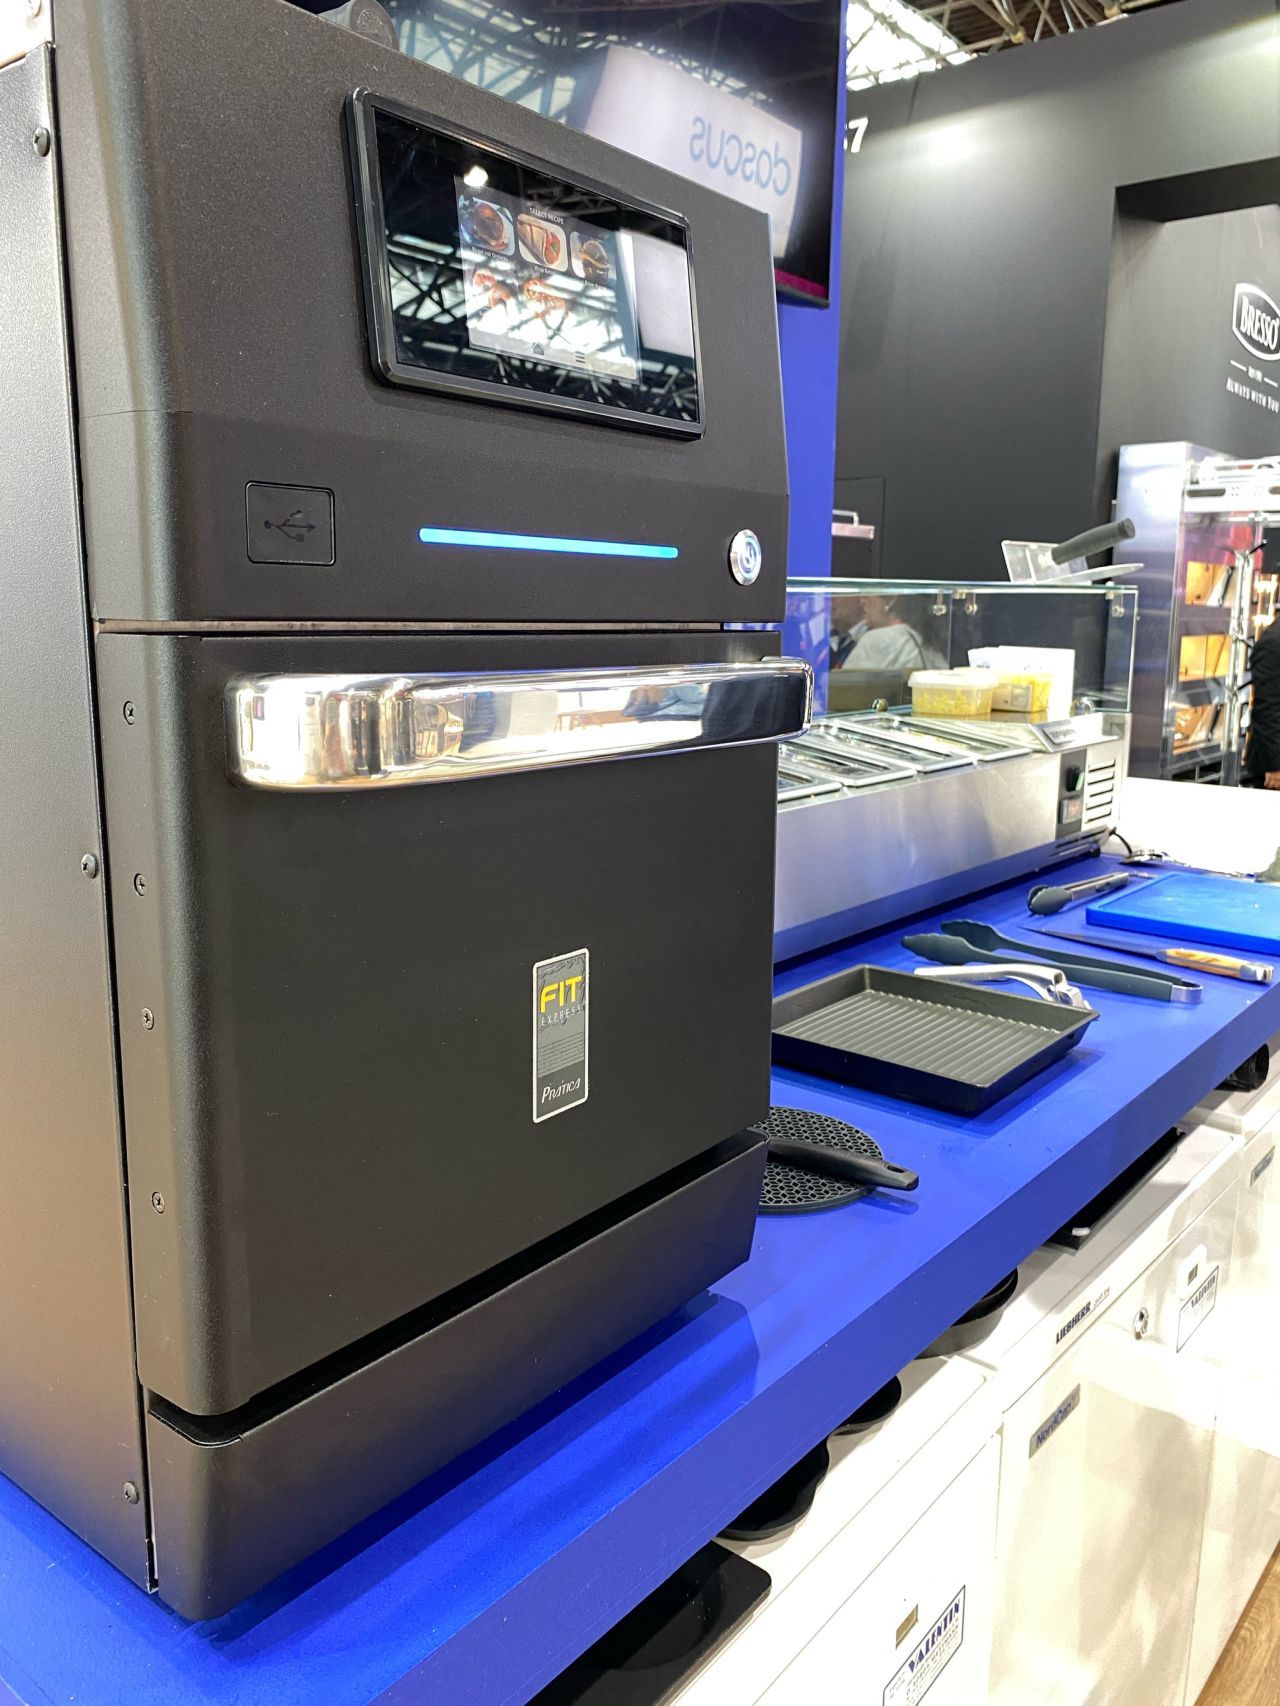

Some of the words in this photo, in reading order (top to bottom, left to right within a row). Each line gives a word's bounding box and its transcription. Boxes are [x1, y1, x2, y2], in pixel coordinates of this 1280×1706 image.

[843, 116, 869, 154] 7
[529, 207, 548, 220] SELECT
[540, 975, 583, 1014] FIT
[541, 1004, 582, 1027] EXPRESS
[1056, 1301, 1091, 1344] LIEBHERR
[908, 1598, 960, 1674] VALENTIN
